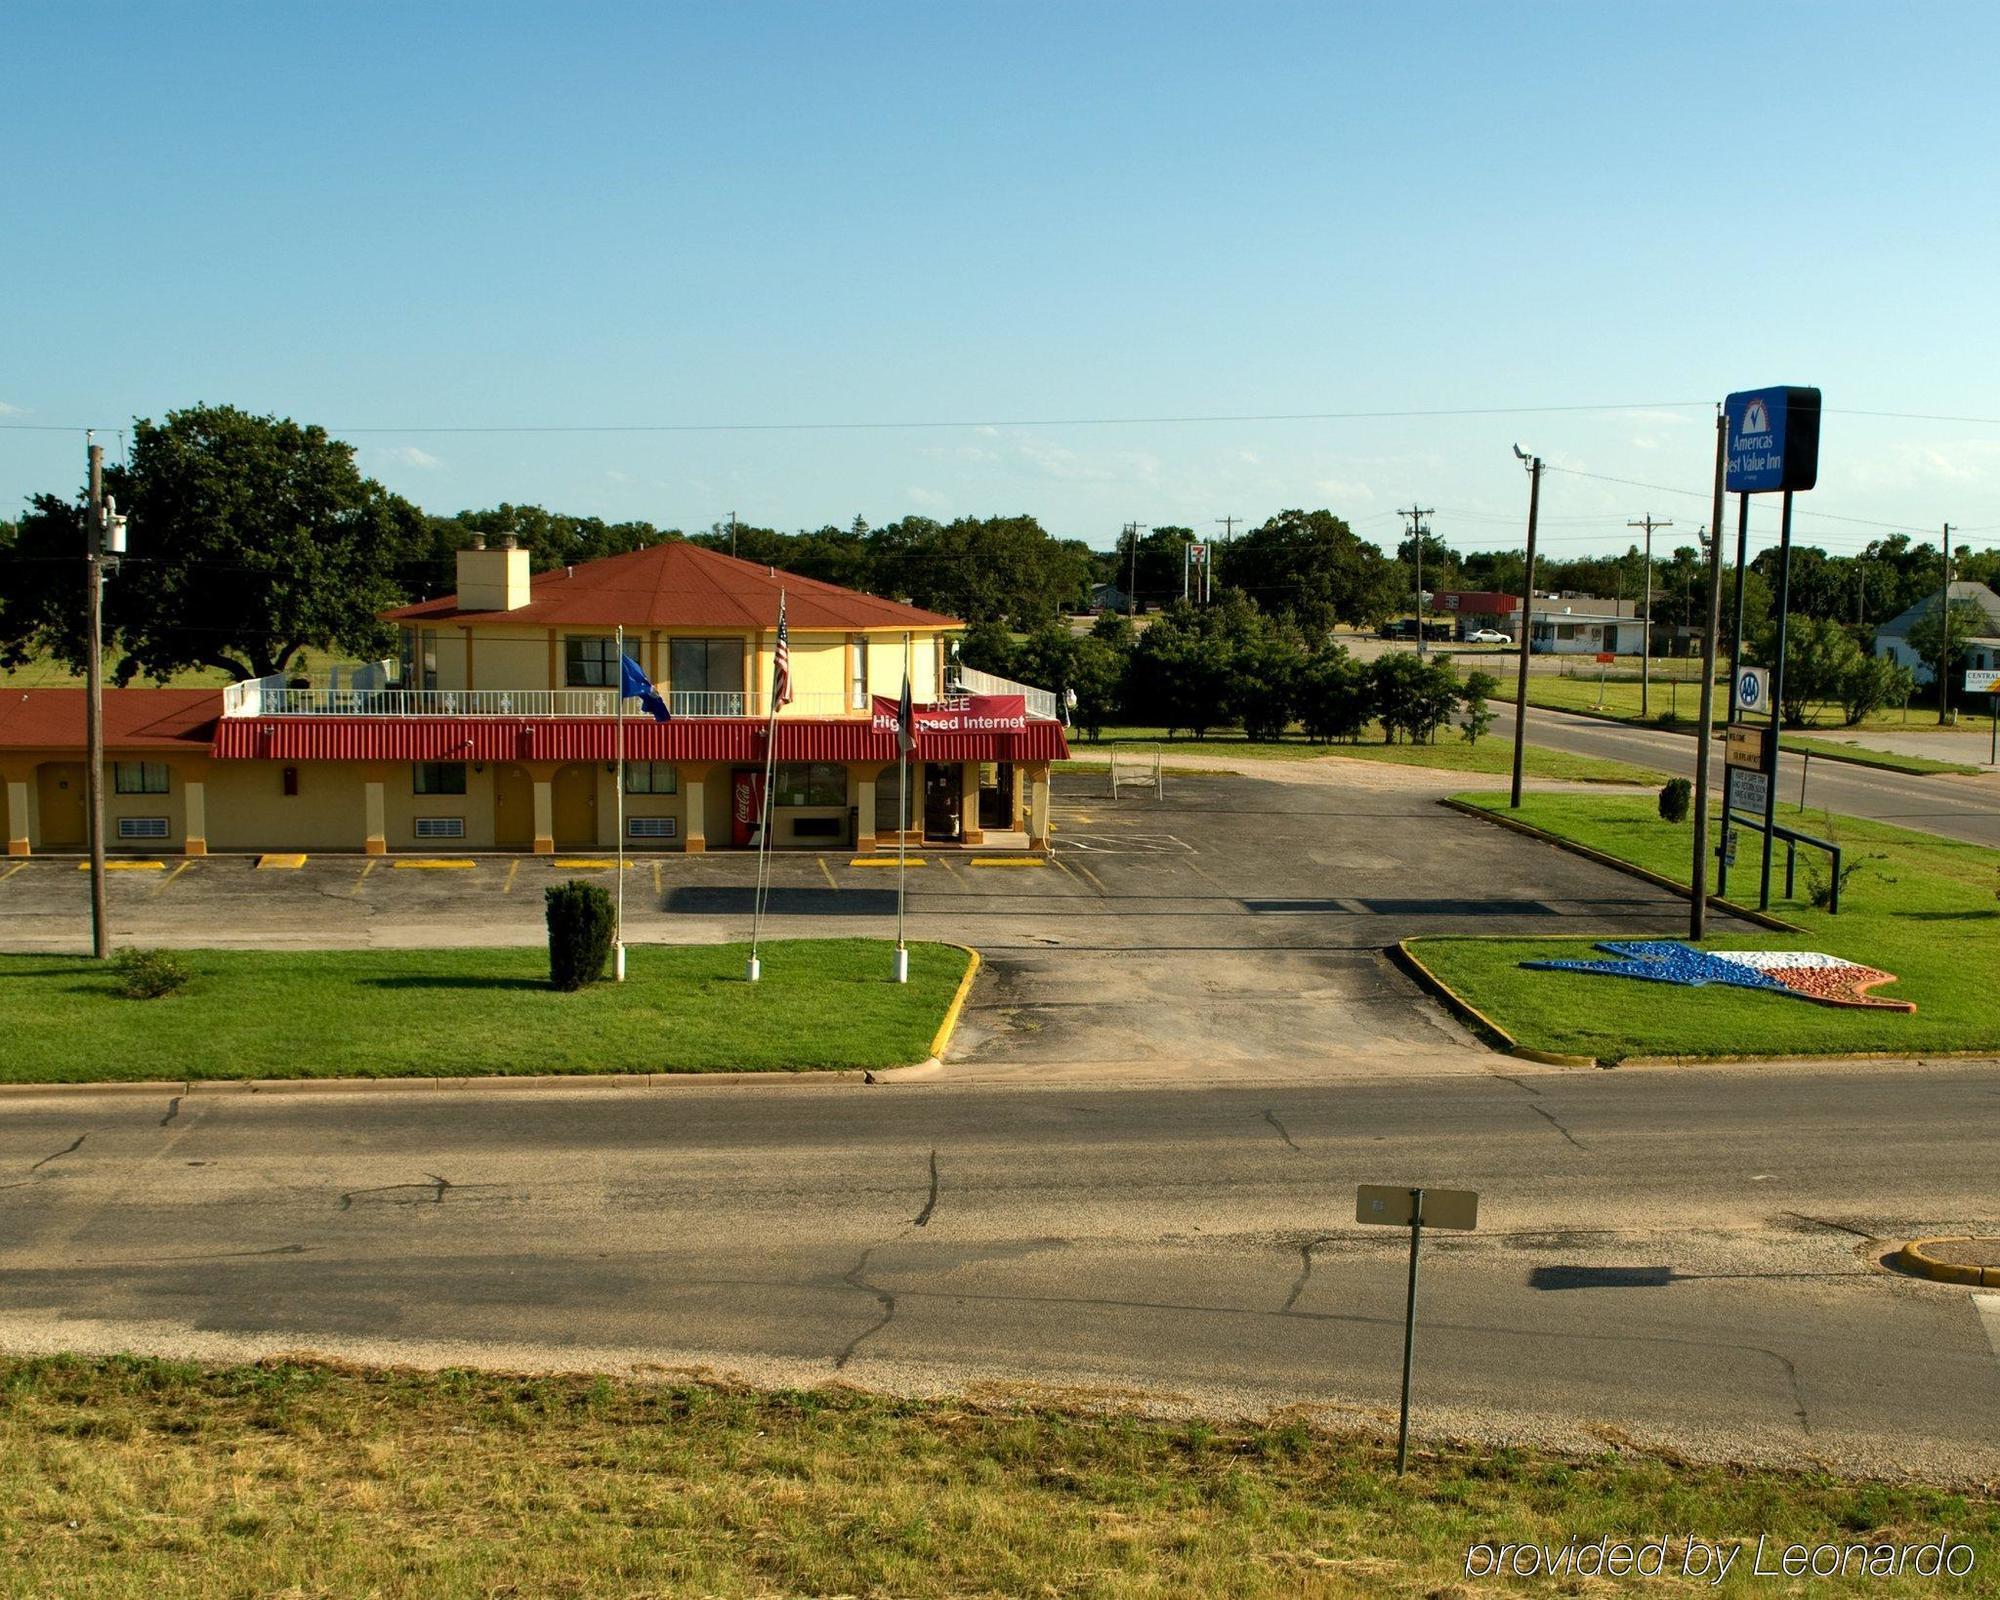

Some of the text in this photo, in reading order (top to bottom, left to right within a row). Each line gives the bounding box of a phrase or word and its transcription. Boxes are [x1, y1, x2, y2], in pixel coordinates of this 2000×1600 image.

[1728, 452, 1781, 472] est Value Inn
[927, 698, 970, 712] FREE
[873, 715, 900, 731] Hig
[964, 715, 1025, 729] Internet
